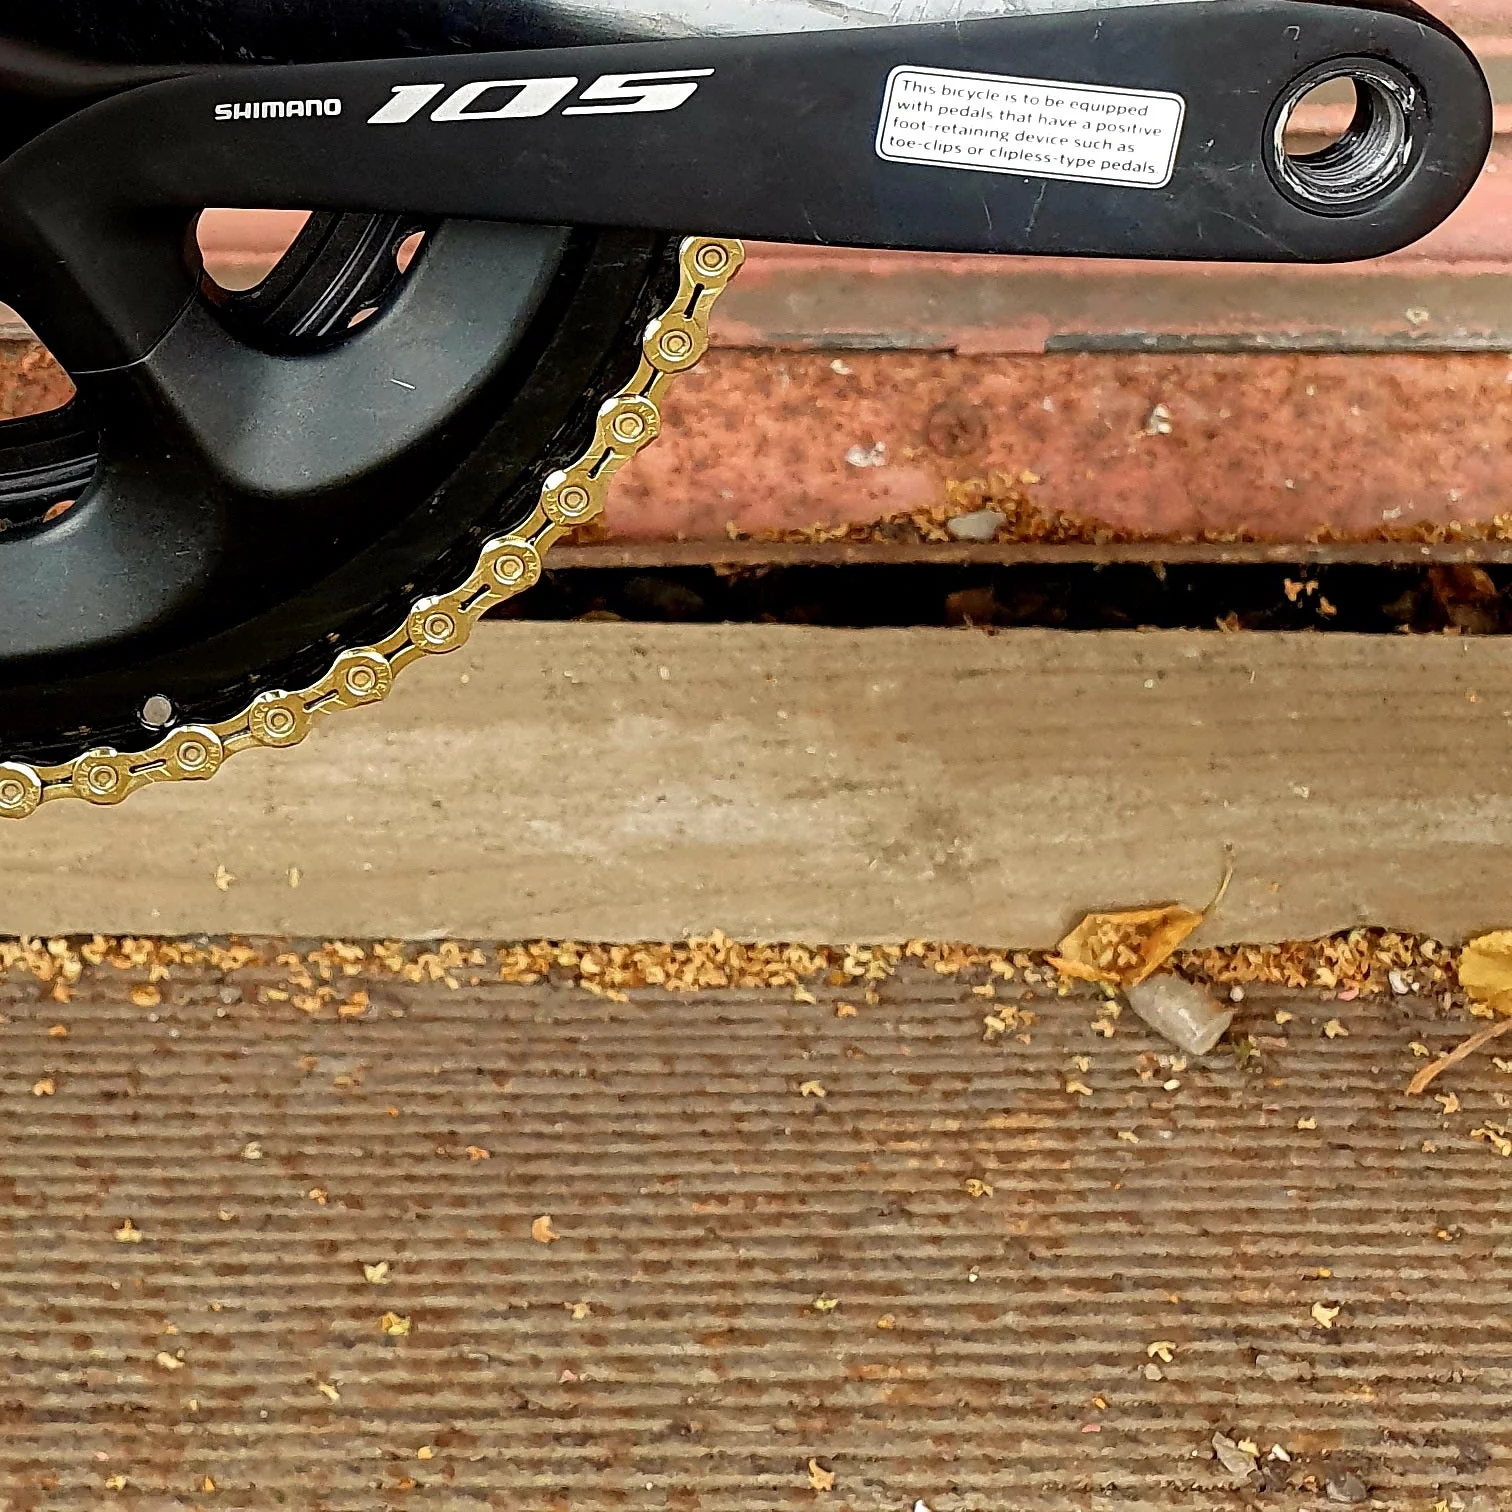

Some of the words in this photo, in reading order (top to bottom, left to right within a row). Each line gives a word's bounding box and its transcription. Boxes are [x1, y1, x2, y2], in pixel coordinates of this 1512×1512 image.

[214, 97, 342, 120] SHIMANO
[367, 68, 716, 124] 105
[903, 79, 936, 95] This
[941, 84, 1000, 101] bicycle
[1005, 94, 1018, 103] is
[1023, 94, 1039, 106] to
[1045, 95, 1065, 107] be
[1069, 100, 1149, 116] equipped
[893, 116, 1010, 143] foot-retaining
[1014, 130, 1069, 146] device
[1074, 138, 1112, 150] such
[1117, 143, 1135, 153] as
[897, 101, 933, 112] with
[938, 106, 993, 120] pedals
[999, 110, 1032, 124] that
[1038, 113, 1077, 128] have
[1082, 121, 1091, 130] a
[1096, 122, 1162, 137] positive
[889, 136, 962, 155] toe-clips
[967, 146, 985, 155] or
[989, 146, 1096, 169] clipless-type
